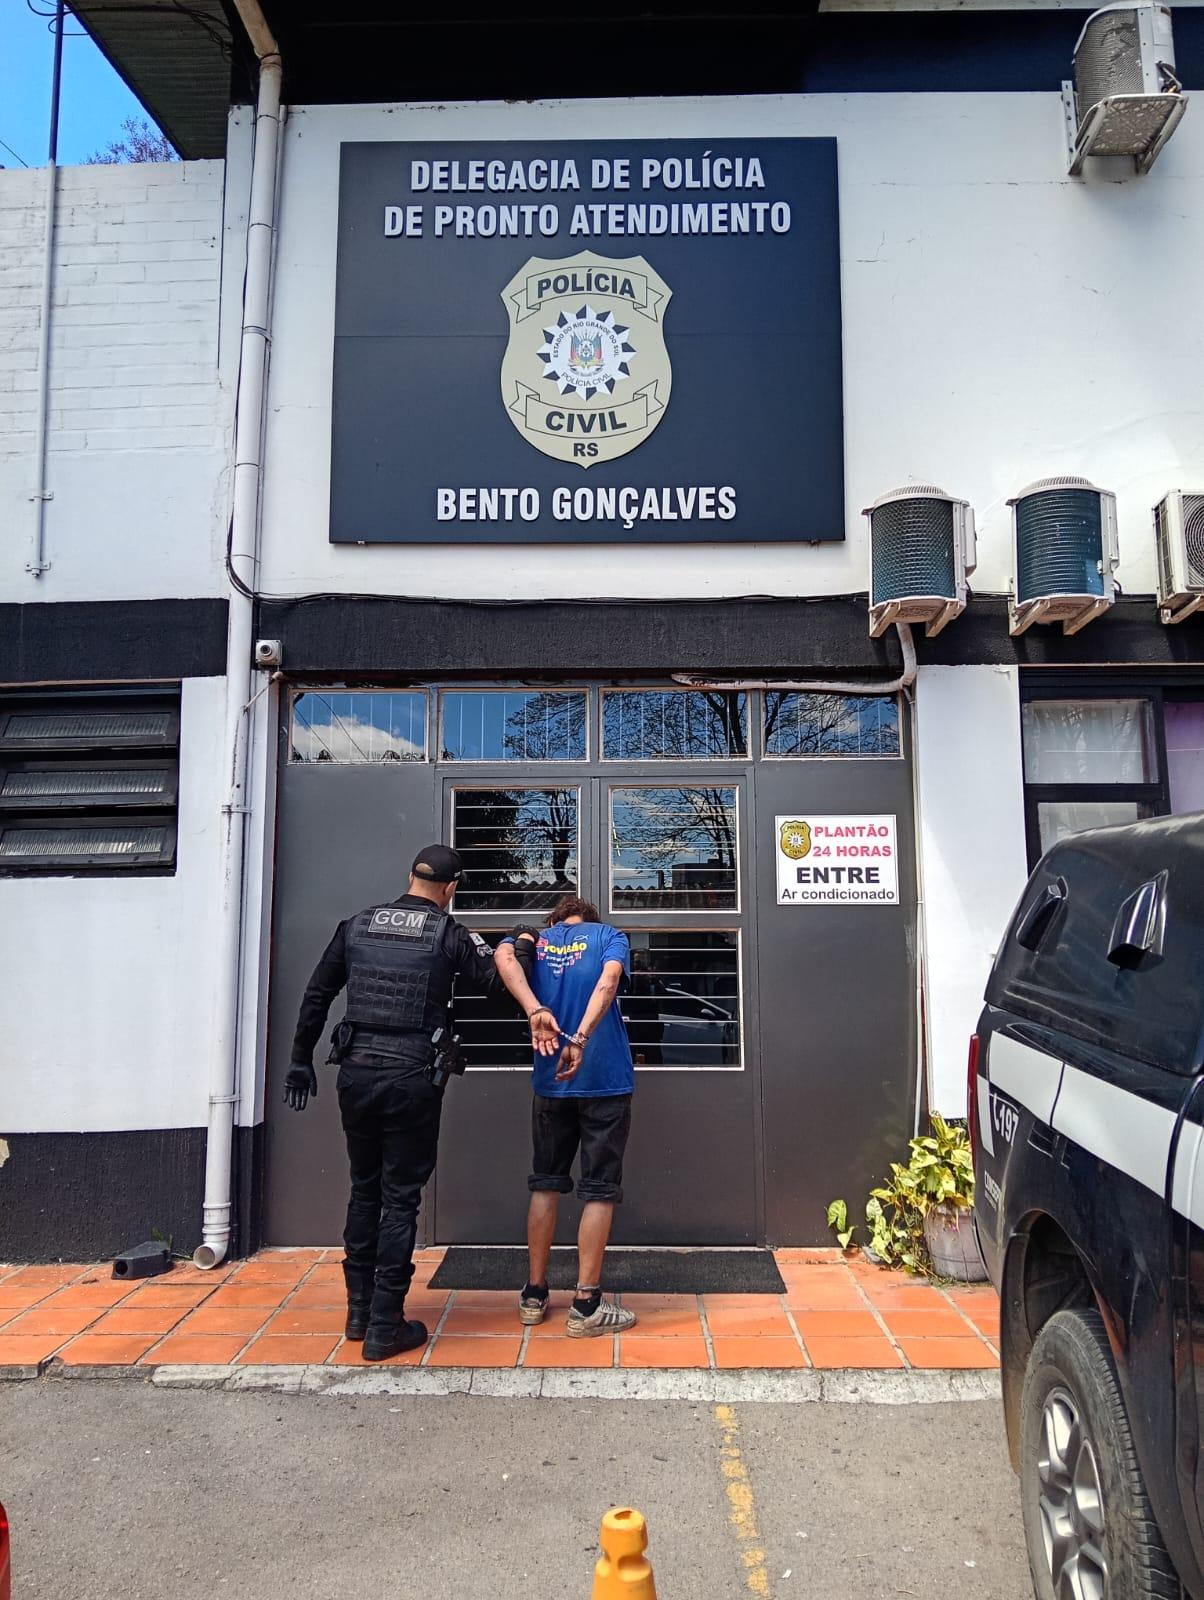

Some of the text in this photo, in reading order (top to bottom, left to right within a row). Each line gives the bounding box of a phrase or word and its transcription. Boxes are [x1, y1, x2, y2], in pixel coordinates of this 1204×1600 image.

[411, 150, 766, 191] DELEGACIA DE POLÍCIA
[384, 201, 791, 236] DE PRONTO ATENDIMENTO
[537, 268, 636, 299] POLÍCIA
[553, 333, 565, 358] ESTADO
[563, 326, 573, 335] DO
[573, 321, 584, 329] RIO
[586, 321, 611, 336] GRANDE
[609, 334, 617, 344] DO
[592, 373, 612, 385] CIVIL
[545, 410, 627, 433] CIVIL
[573, 442, 599, 457] RS
[437, 486, 737, 529] BENTO GONÇALVES
[814, 824, 889, 837] PLANTÃO
[812, 845, 892, 857] 24 HORAS
[796, 867, 881, 884] ENTRE
[781, 888, 895, 900] Ar condicionado
[374, 910, 426, 929] GCM
[1000, 1103, 1019, 1147] 197
